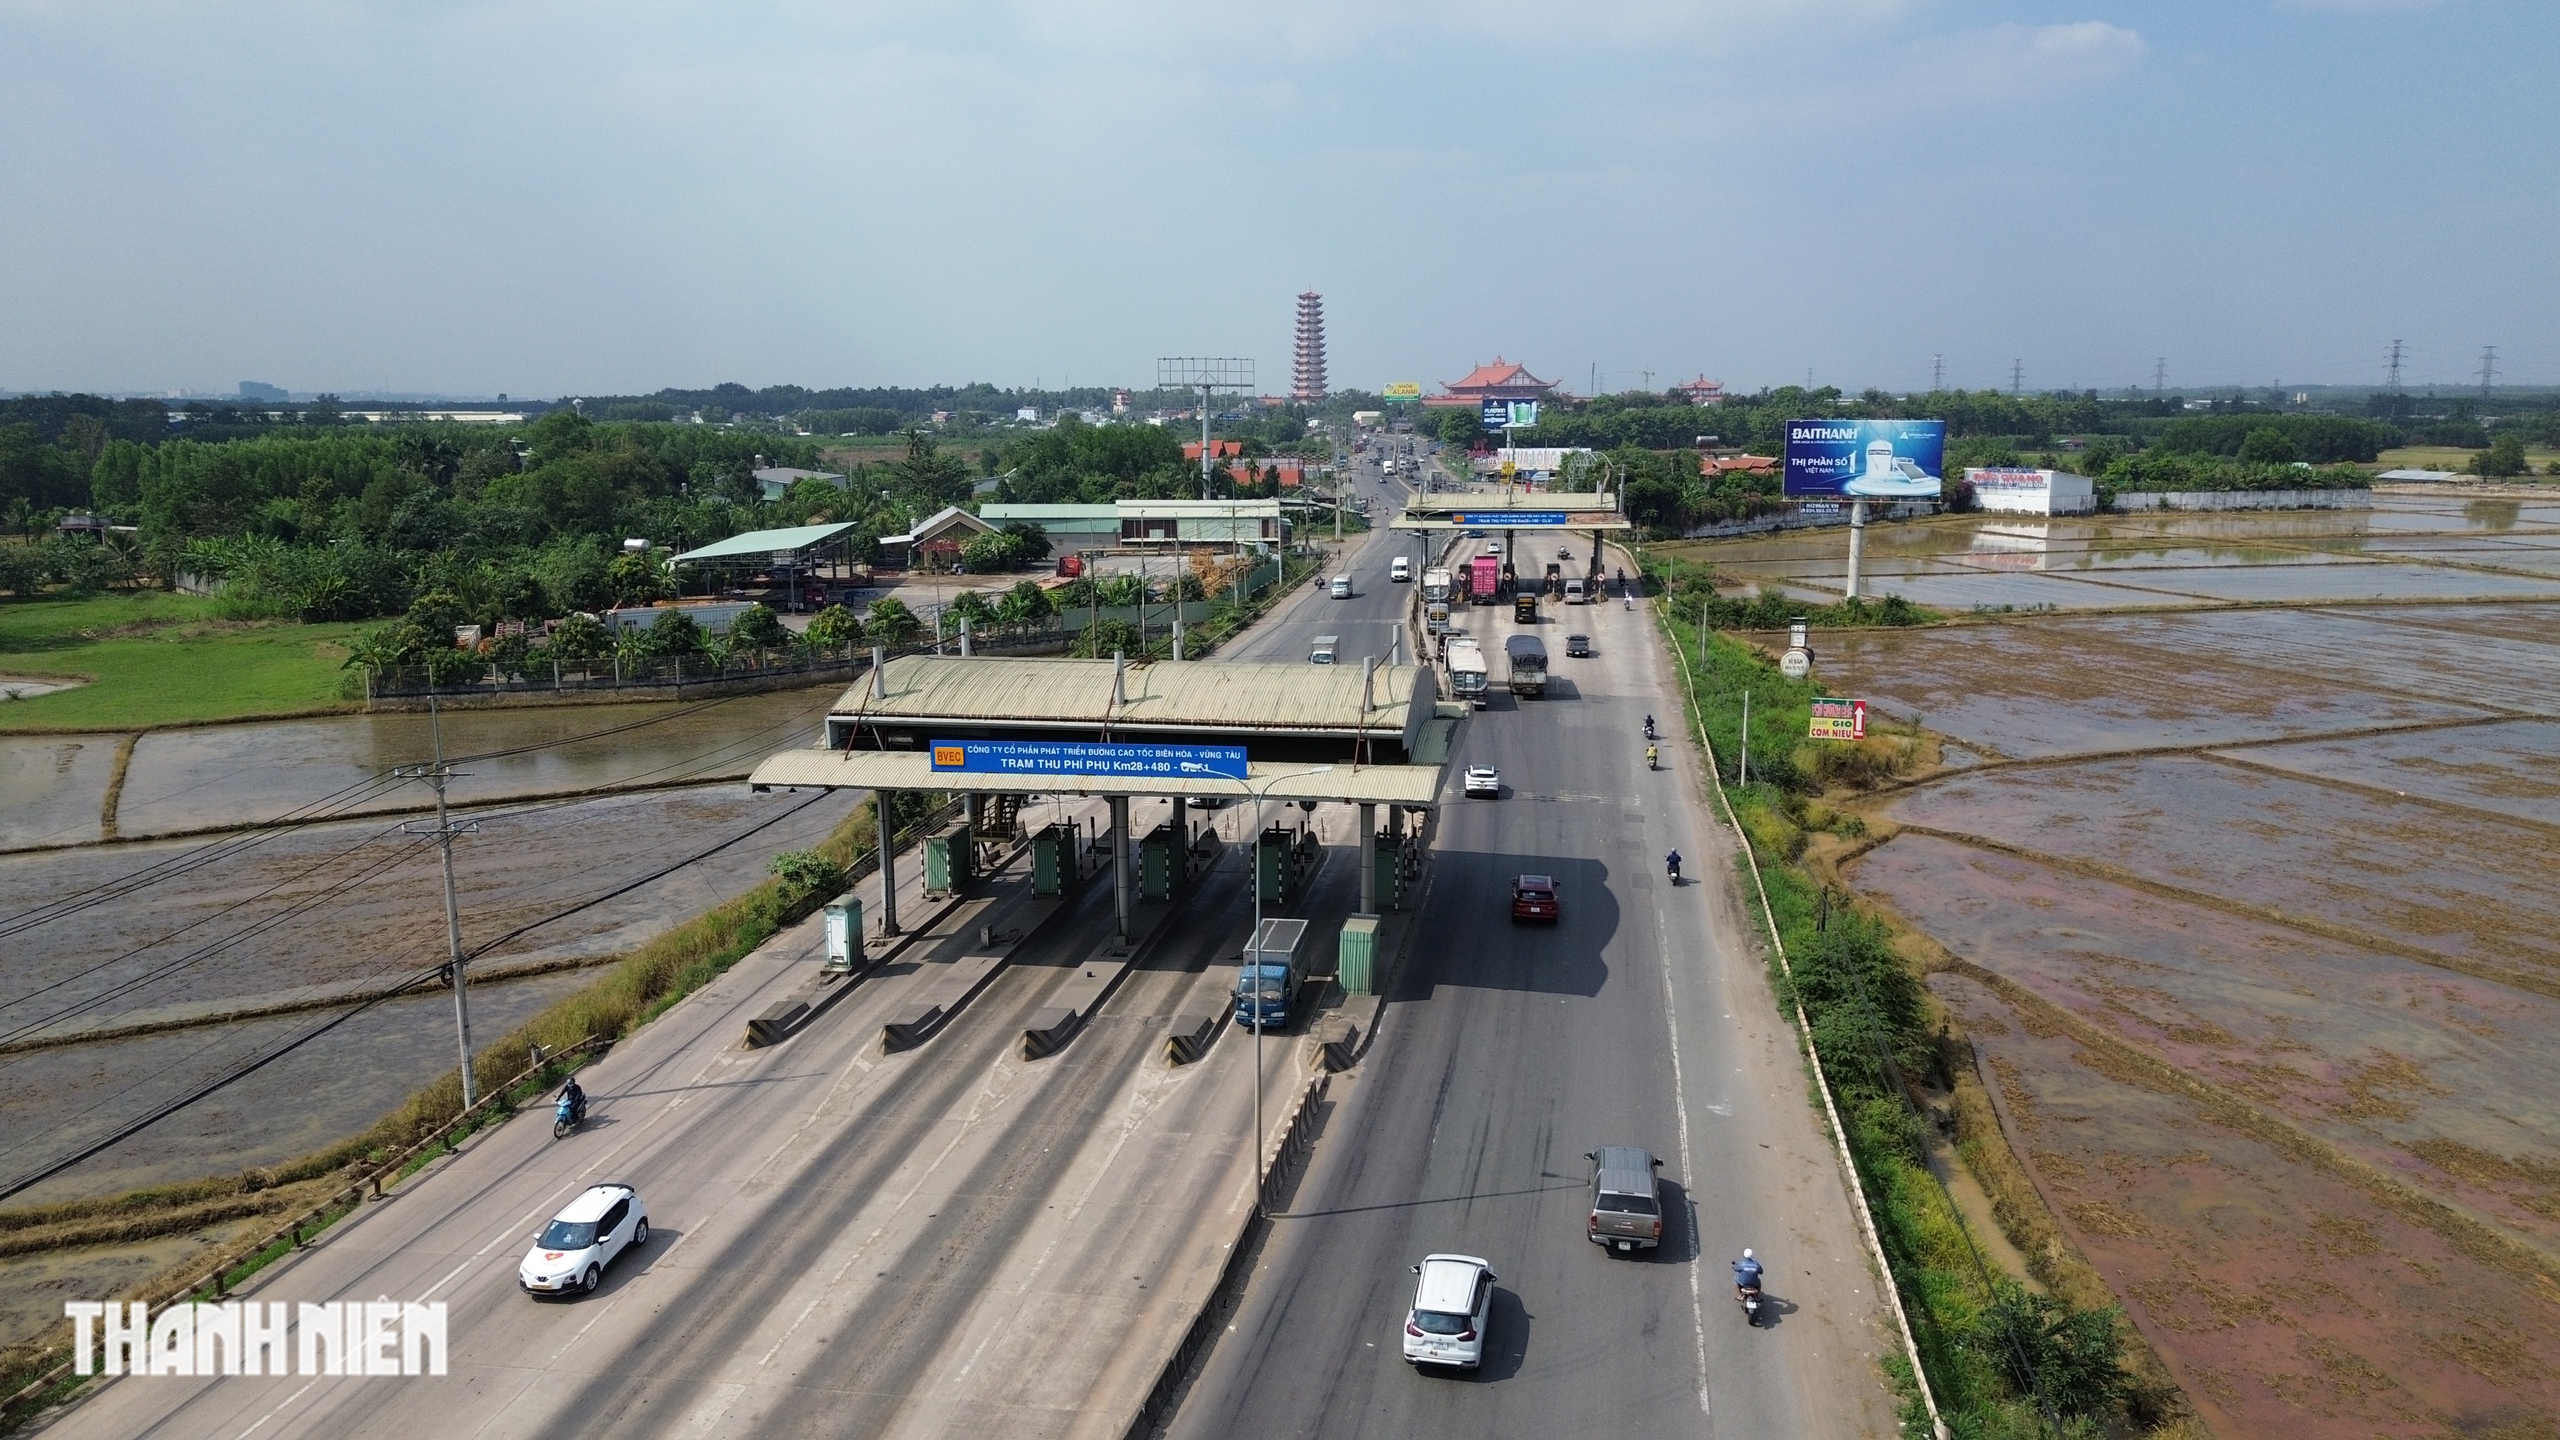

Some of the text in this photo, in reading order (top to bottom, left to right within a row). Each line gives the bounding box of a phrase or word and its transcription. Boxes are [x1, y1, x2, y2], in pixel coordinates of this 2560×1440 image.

[1808, 456, 1833, 466] PHẦN
[1848, 450, 1858, 474] 1
[937, 751, 961, 762] BVEC
[967, 744, 990, 753] CÔNG
[1004, 743, 1015, 754] CỔ
[1017, 745, 1039, 755] PHẦN
[1040, 745, 1061, 755] PHÁT
[1063, 744, 1085, 756] TRIỂN
[1088, 747, 1116, 757] ĐƯỜNG
[1118, 749, 1134, 757] CAO
[1136, 747, 1154, 757] TỐC
[1155, 748, 1174, 758] BIÊN
[1199, 749, 1222, 759] VŨNG
[1225, 749, 1241, 760] TÀU
[1000, 758, 1034, 770] TRẠM
[1037, 759, 1061, 769] THU
[1064, 758, 1083, 770] PHÍ
[1086, 760, 1110, 772] PHỤ
[1113, 761, 1171, 772] Km28+480
